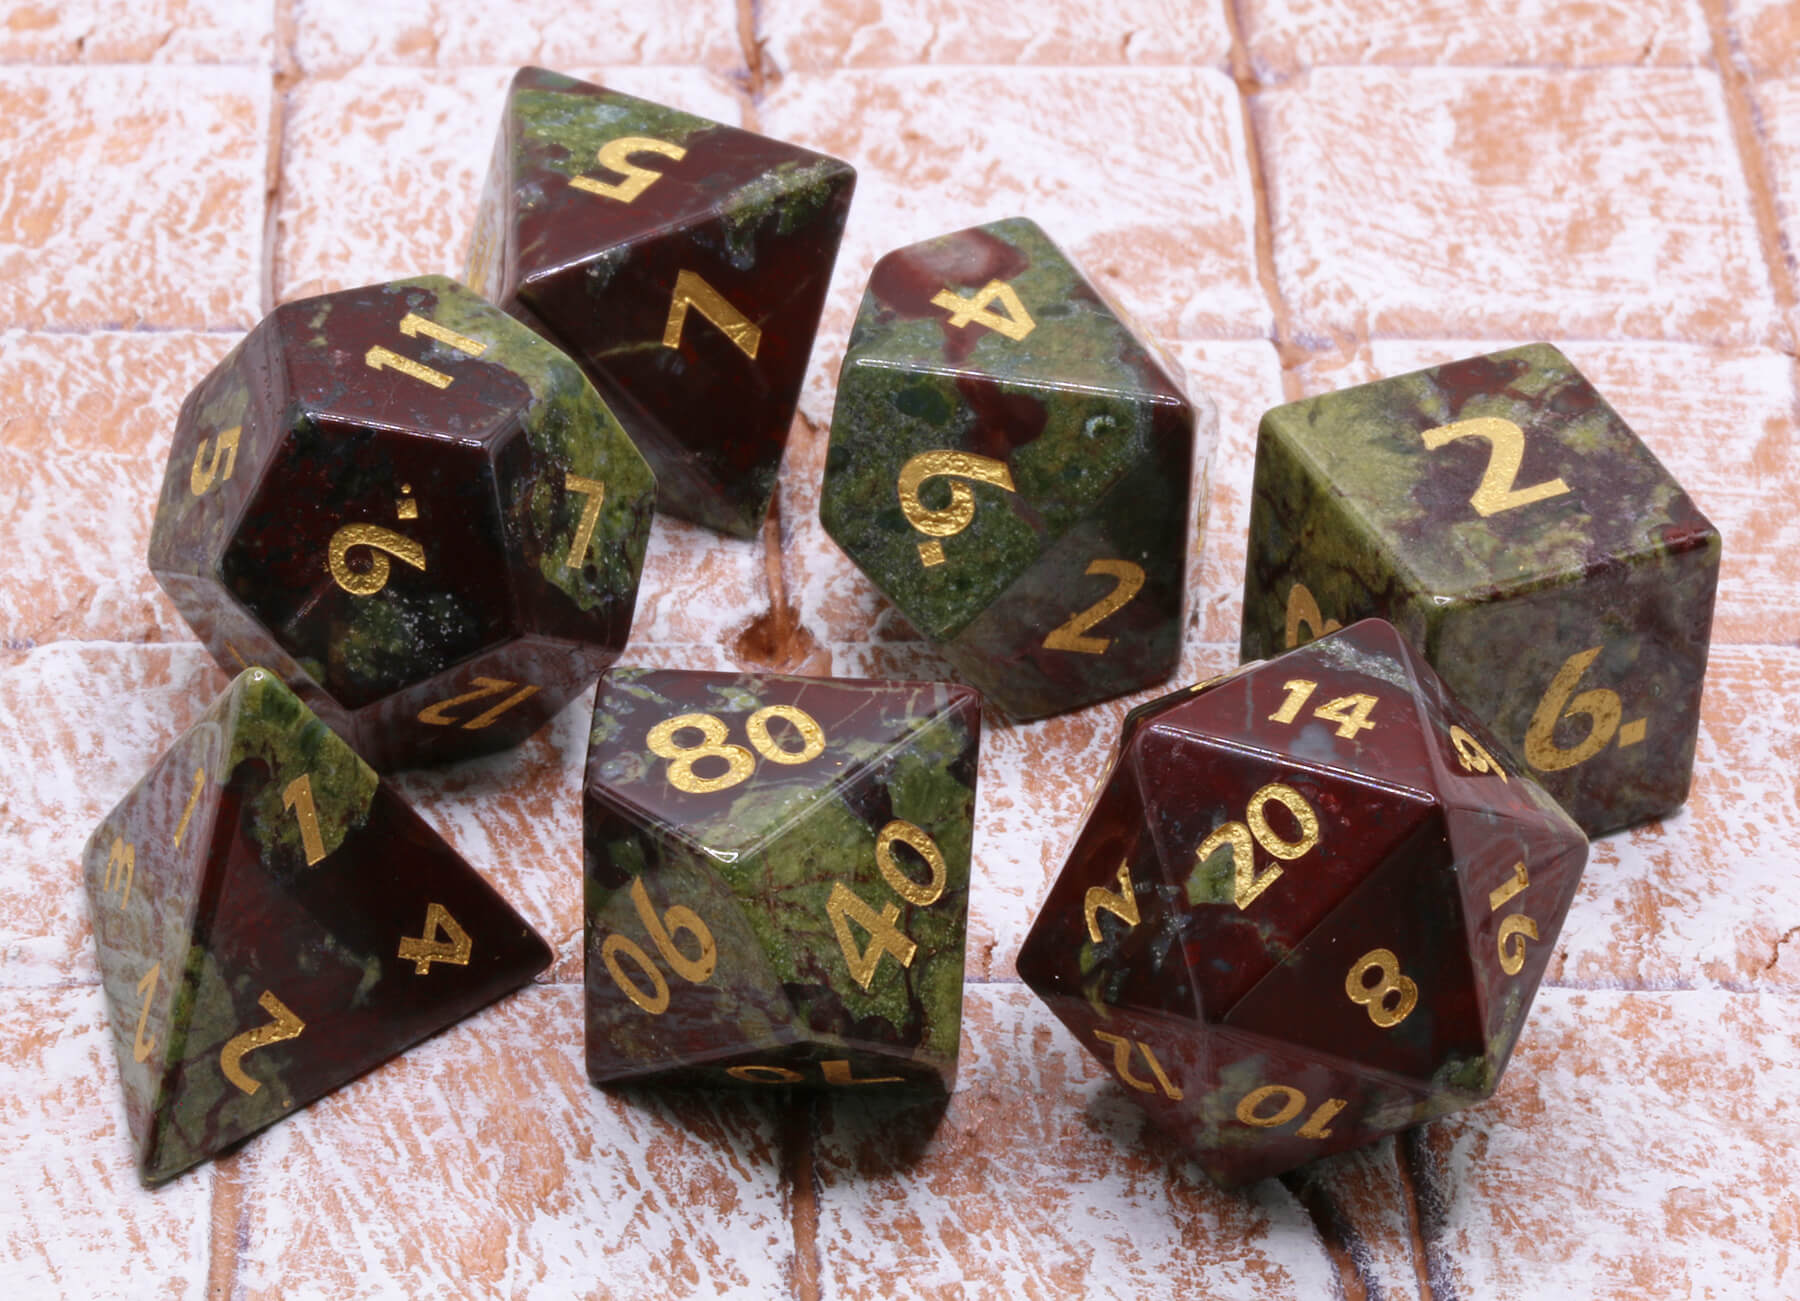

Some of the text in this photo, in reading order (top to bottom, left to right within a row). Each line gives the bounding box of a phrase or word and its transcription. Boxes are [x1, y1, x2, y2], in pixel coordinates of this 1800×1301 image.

[568, 136, 687, 204] 5
[364, 312, 488, 390] 11
[662, 269, 762, 360] 7
[930, 278, 1036, 341] 4
[190, 426, 242, 496] 5
[1421, 416, 1571, 517] 2
[565, 472, 605, 569] 7
[1042, 559, 1146, 654] 2
[646, 705, 826, 794] 80
[1268, 679, 1380, 740] 14
[282, 773, 326, 866] 1
[1196, 783, 1320, 911] 20
[103, 836, 135, 910] 3
[825, 819, 947, 991] 40
[1084, 857, 1141, 943] 2
[398, 903, 473, 975] 4
[1345, 948, 1418, 1029] 8
[220, 989, 306, 1096] 2
